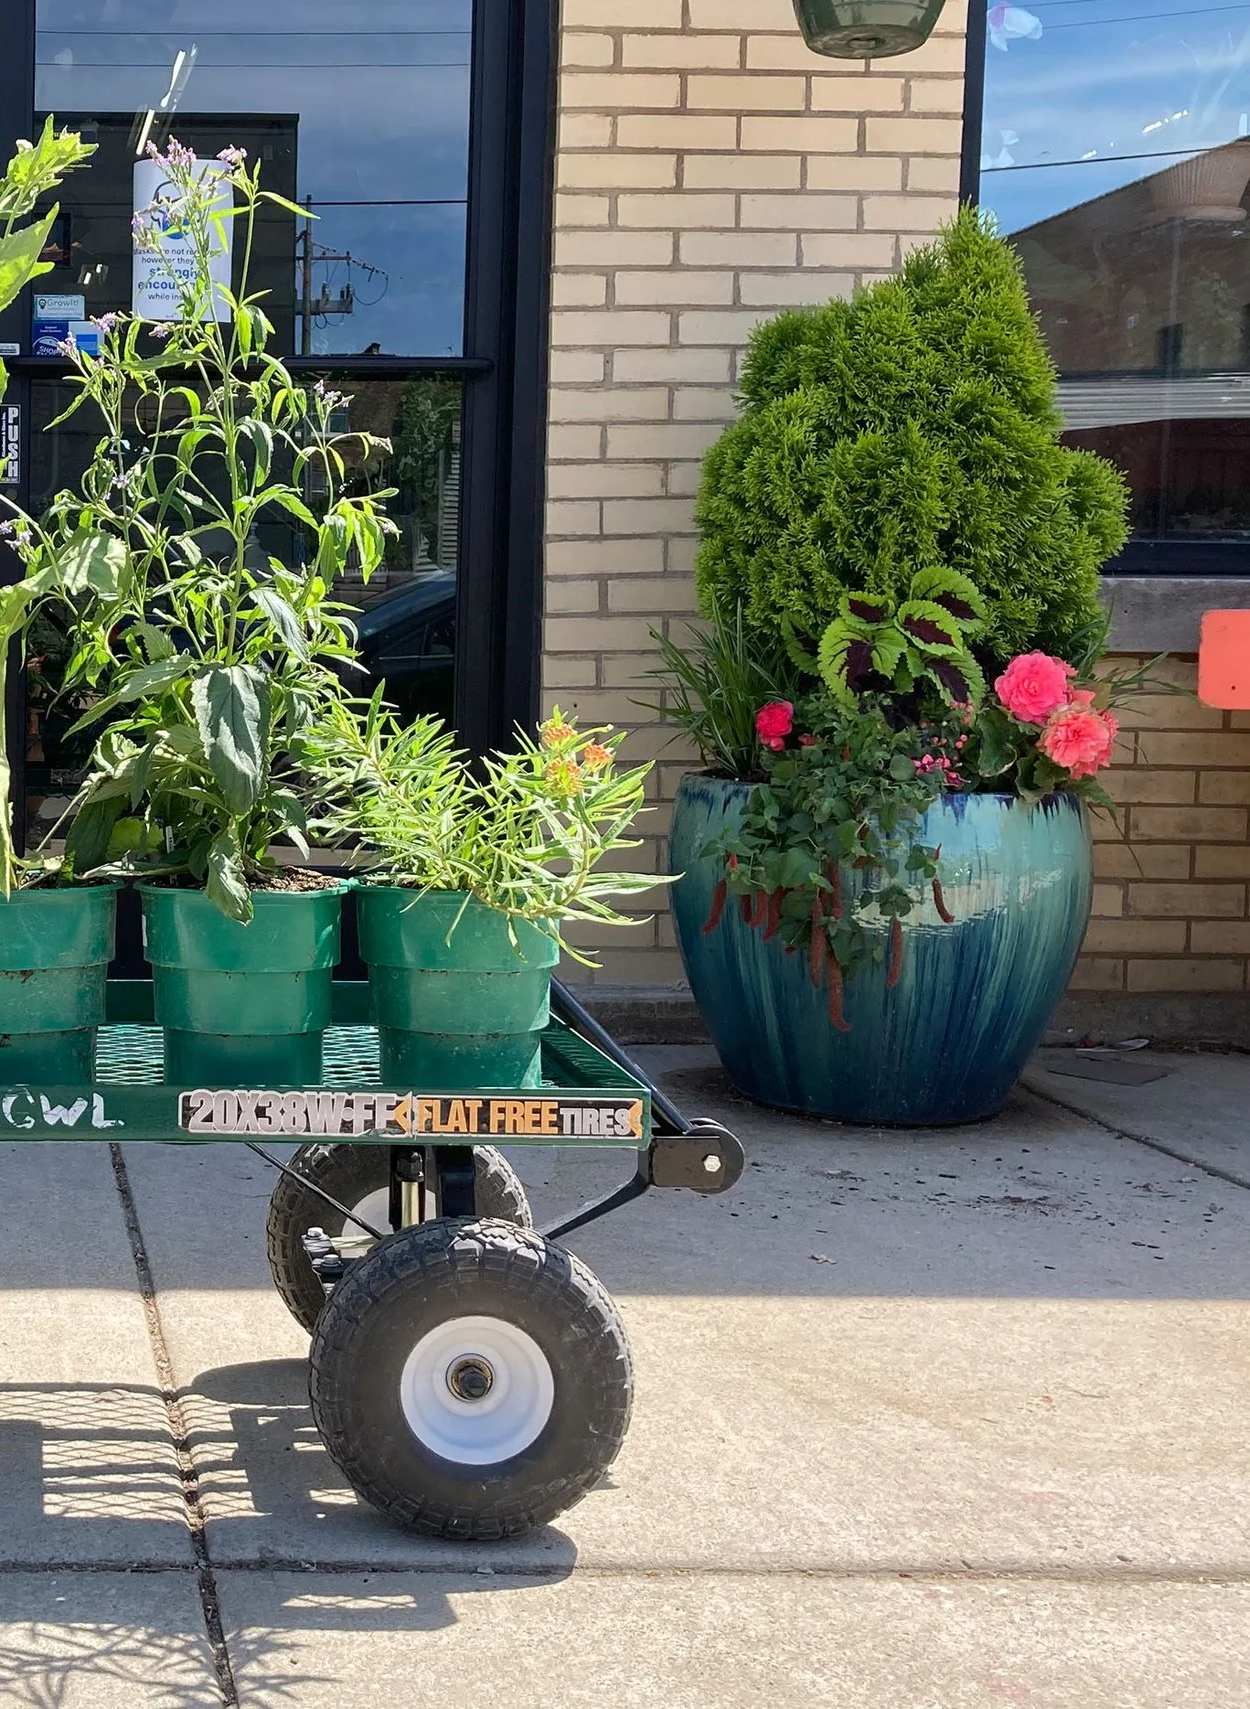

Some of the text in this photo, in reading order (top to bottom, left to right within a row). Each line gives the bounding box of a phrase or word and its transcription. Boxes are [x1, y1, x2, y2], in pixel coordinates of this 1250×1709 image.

[177, 257, 194, 265] they
[7, 407, 19, 477] PUSH
[417, 1099, 630, 1136] FLAT FREE TIRES
